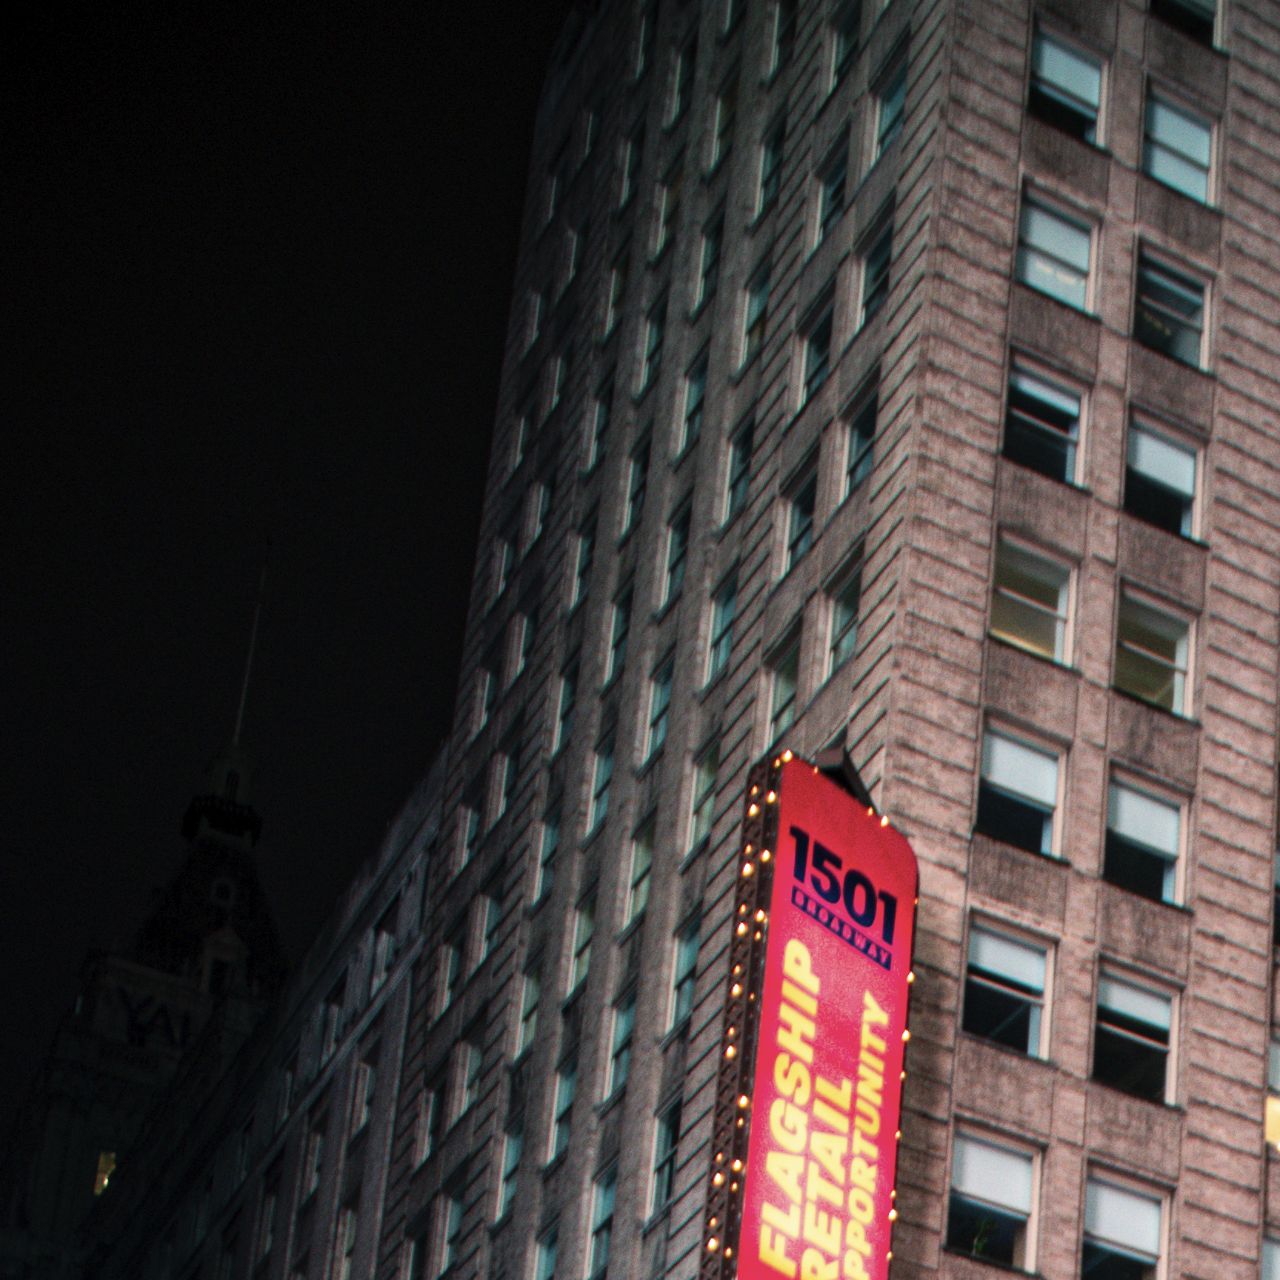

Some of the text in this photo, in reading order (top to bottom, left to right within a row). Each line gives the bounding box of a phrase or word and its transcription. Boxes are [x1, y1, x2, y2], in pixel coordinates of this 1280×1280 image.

[789, 825, 898, 946] 1501
[793, 886, 892, 970] BROADWAY
[759, 938, 821, 1280] FLAGSHIP
